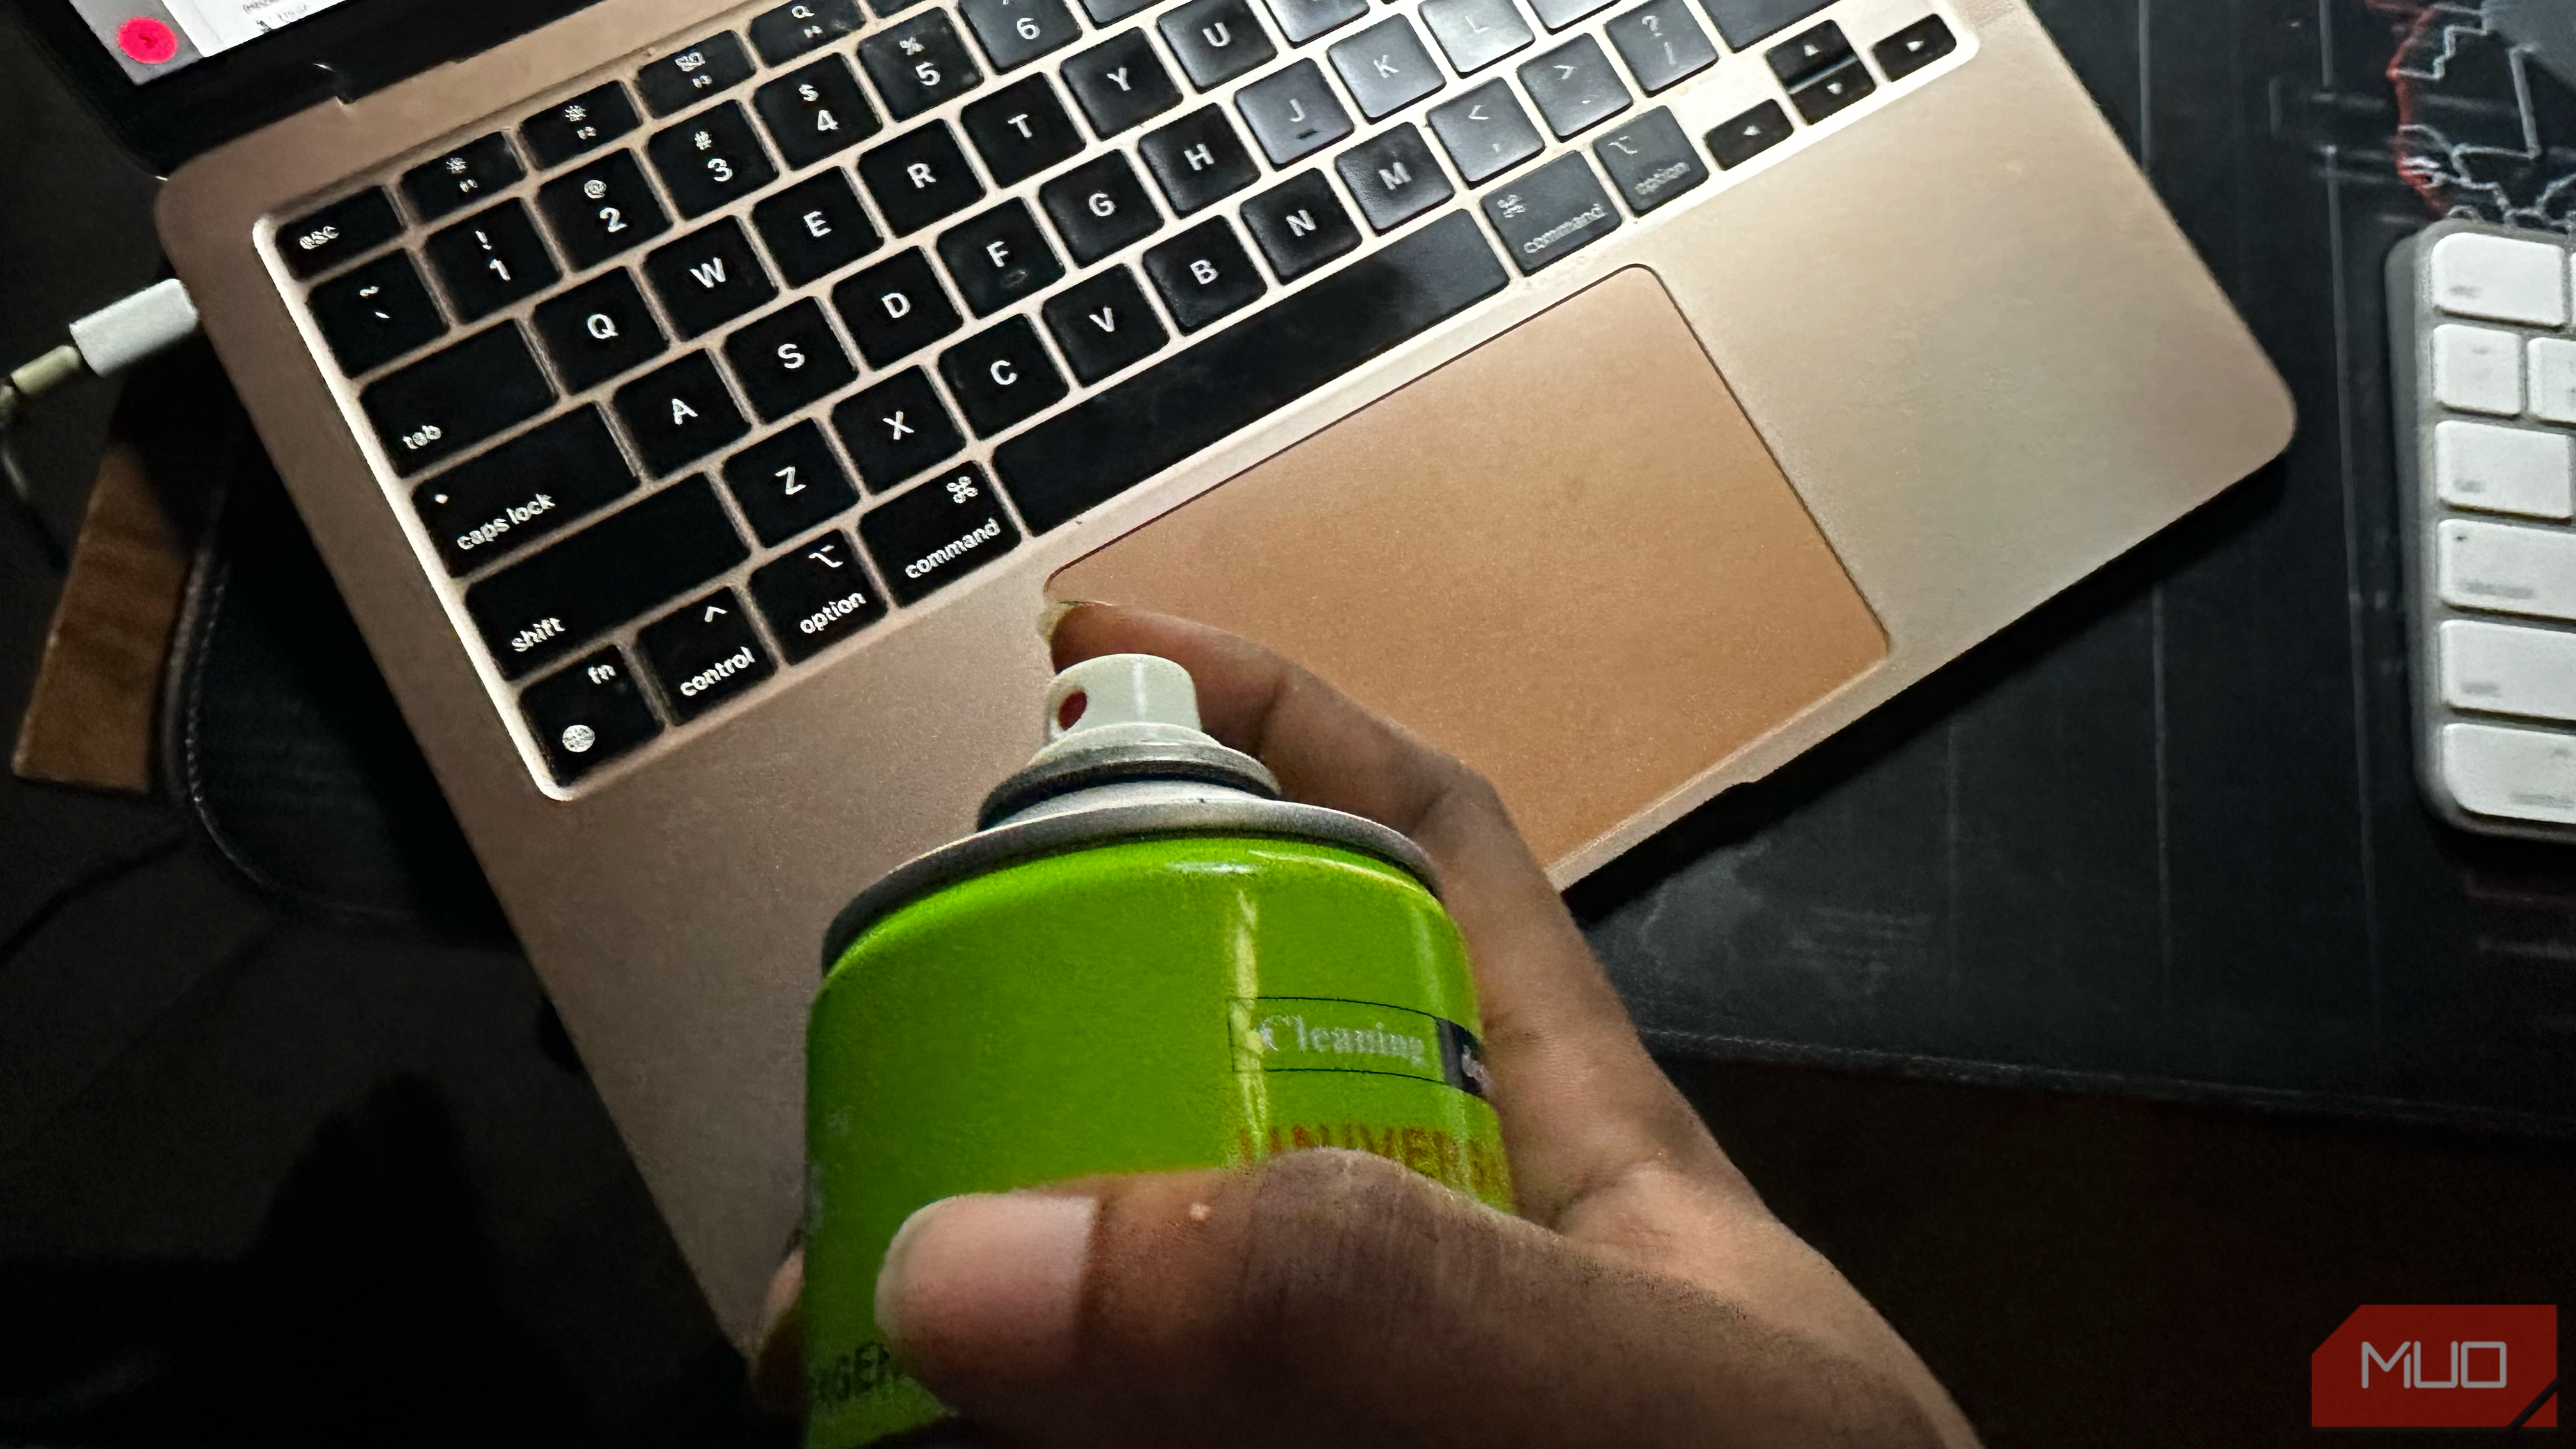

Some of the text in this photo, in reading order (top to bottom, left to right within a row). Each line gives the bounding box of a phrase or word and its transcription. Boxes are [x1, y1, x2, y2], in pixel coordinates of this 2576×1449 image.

[1016, 17, 1040, 40] 6
[1202, 22, 1230, 47] U
[1465, 15, 1489, 34] L
[1641, 15, 1663, 37] ?
[915, 61, 940, 86] 5
[1107, 67, 1131, 91] Y
[1373, 54, 1399, 79] K
[817, 109, 839, 132] 4
[1289, 98, 1306, 123] J
[1007, 114, 1032, 138] T
[1184, 143, 1215, 171] H
[707, 158, 733, 182] 3
[907, 163, 937, 188] R
[1378, 162, 1411, 190] M
[1088, 192, 1115, 217] G
[599, 207, 627, 233] 2
[803, 210, 832, 238] E
[1285, 210, 1316, 237] N
[299, 226, 339, 250] esc
[475, 230, 492, 250] !
[986, 241, 1009, 268] F
[489, 259, 511, 281] 1
[689, 257, 726, 288] W
[1190, 259, 1218, 285] B
[881, 293, 911, 319] D
[586, 313, 618, 339] Q
[1089, 307, 1115, 332] V
[778, 343, 805, 369] S
[990, 360, 1017, 385] C
[671, 398, 698, 425] A
[402, 425, 441, 450] tab
[882, 410, 915, 440] X
[774, 466, 807, 495] Z
[457, 493, 556, 550] caps lock
[905, 518, 1000, 578] command
[800, 592, 866, 633] option
[511, 617, 565, 652] shift
[588, 664, 616, 684] fn
[680, 646, 755, 696] control
[1257, 1015, 1426, 1068] Cleaning
